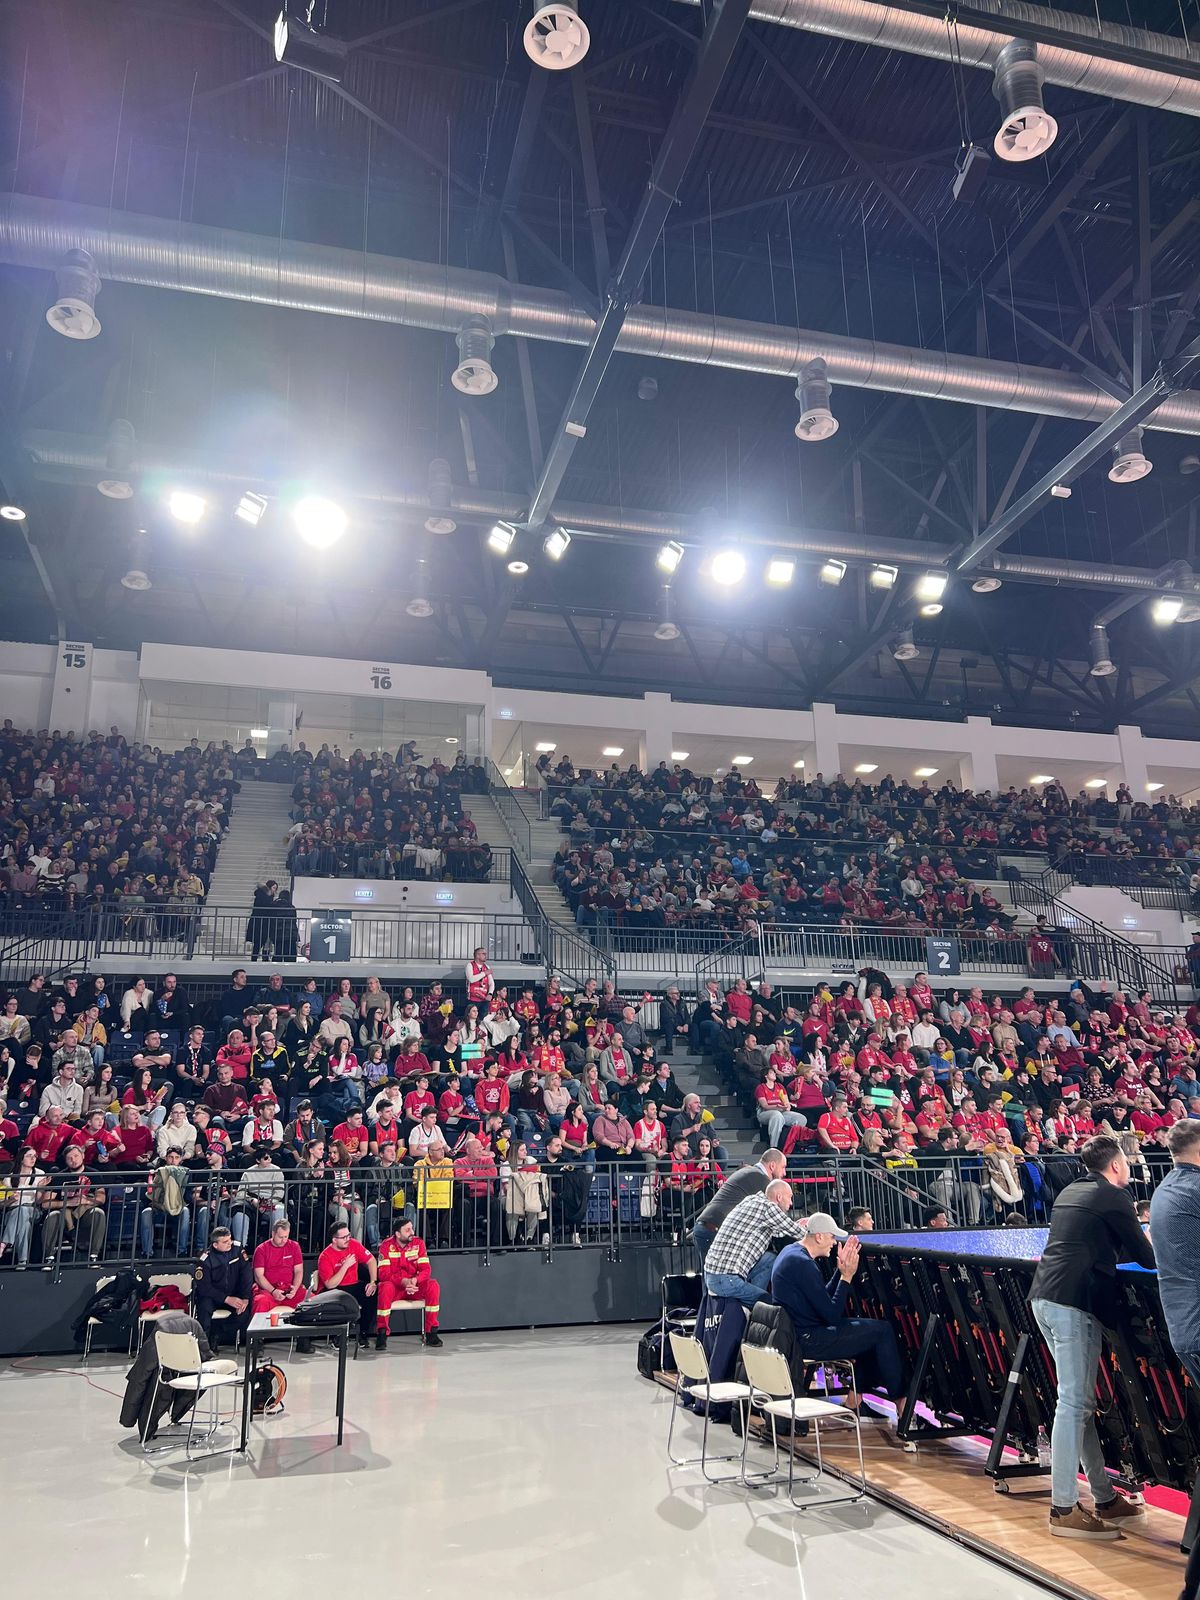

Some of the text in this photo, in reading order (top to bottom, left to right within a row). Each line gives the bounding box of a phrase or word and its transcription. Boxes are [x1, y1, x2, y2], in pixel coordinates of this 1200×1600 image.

[62, 653, 86, 668] 15
[370, 675, 392, 690] 16
[323, 935, 337, 954] 1
[937, 951, 951, 969] 2
